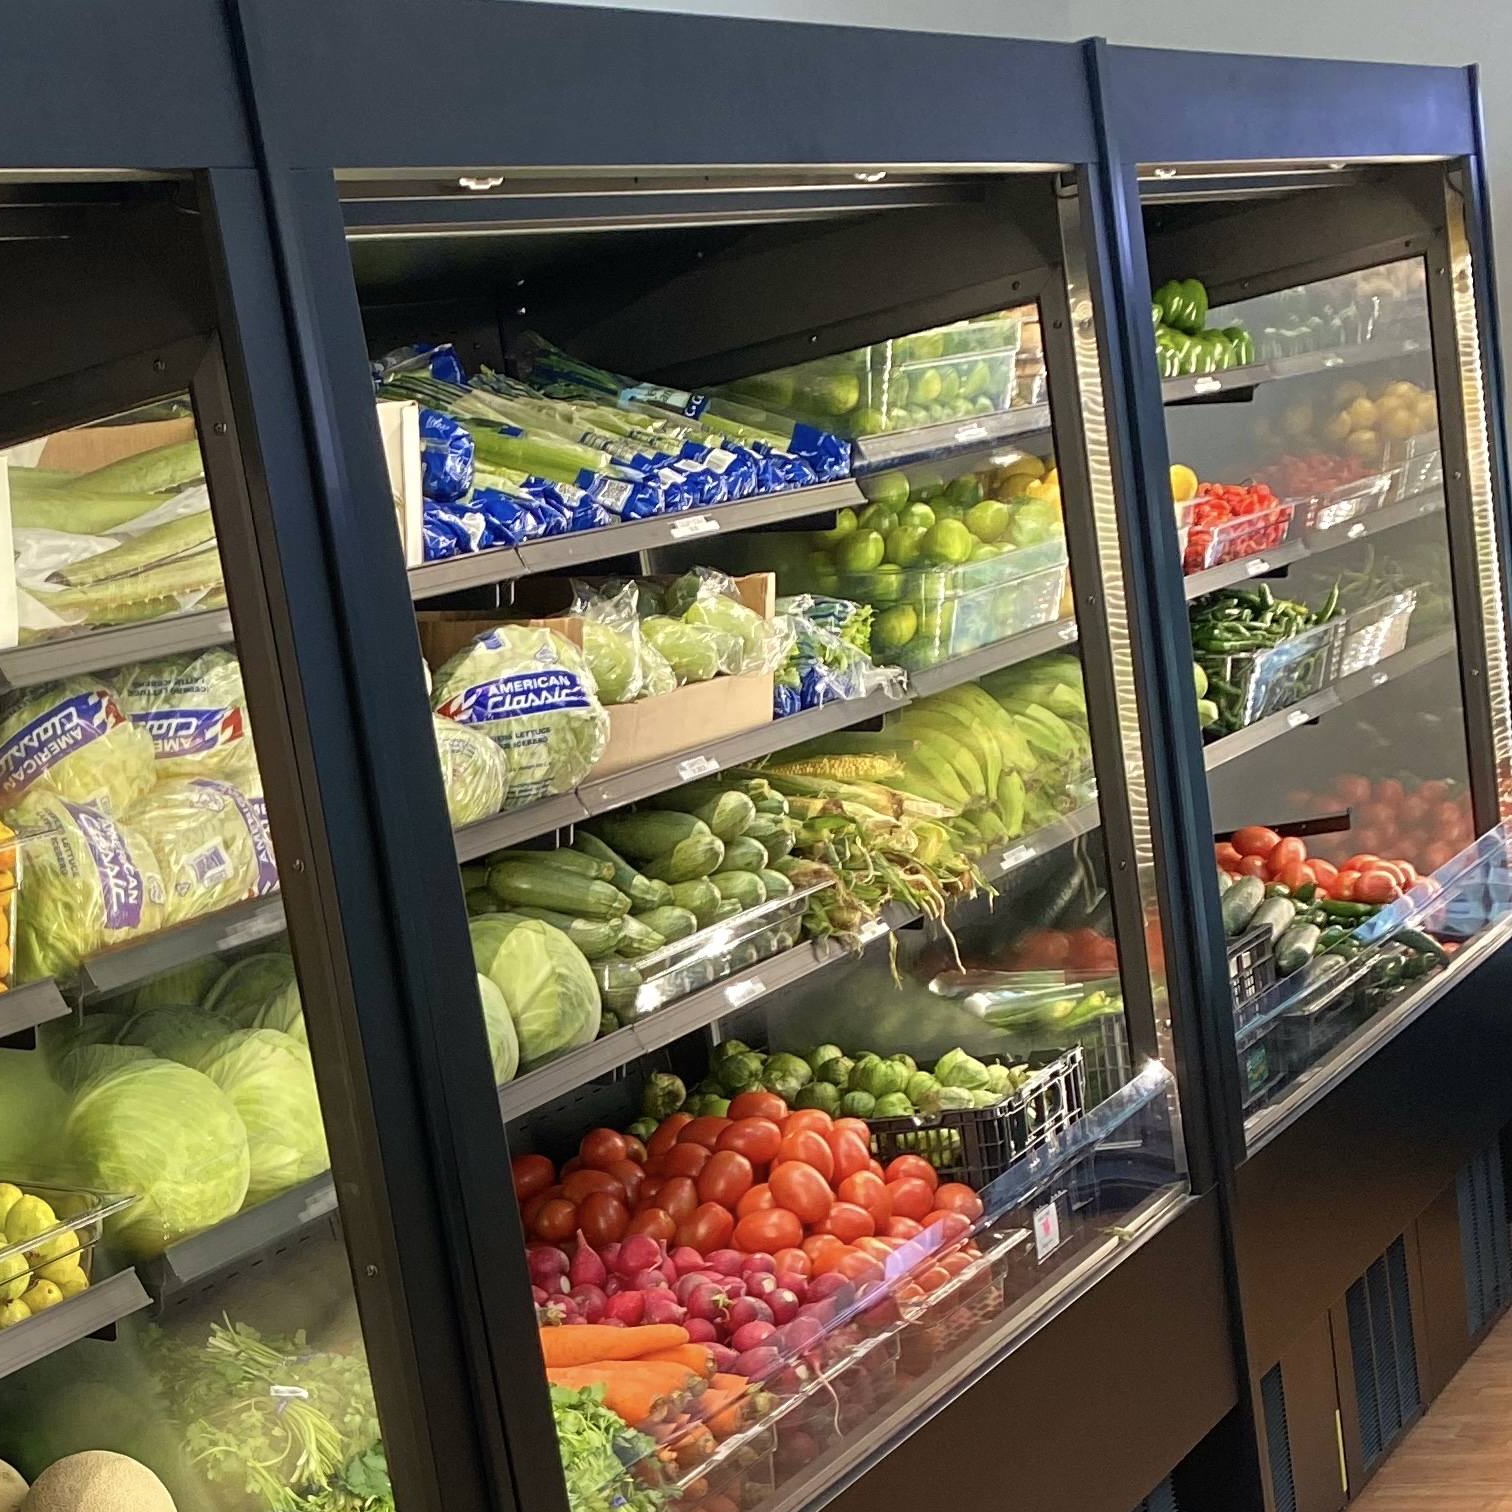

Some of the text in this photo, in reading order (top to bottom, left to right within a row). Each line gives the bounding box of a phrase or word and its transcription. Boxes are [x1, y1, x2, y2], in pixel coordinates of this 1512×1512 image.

[488, 675, 571, 697] AMERICAN
[488, 686, 584, 712] Classic
[3, 726, 83, 791] AMERICAN
